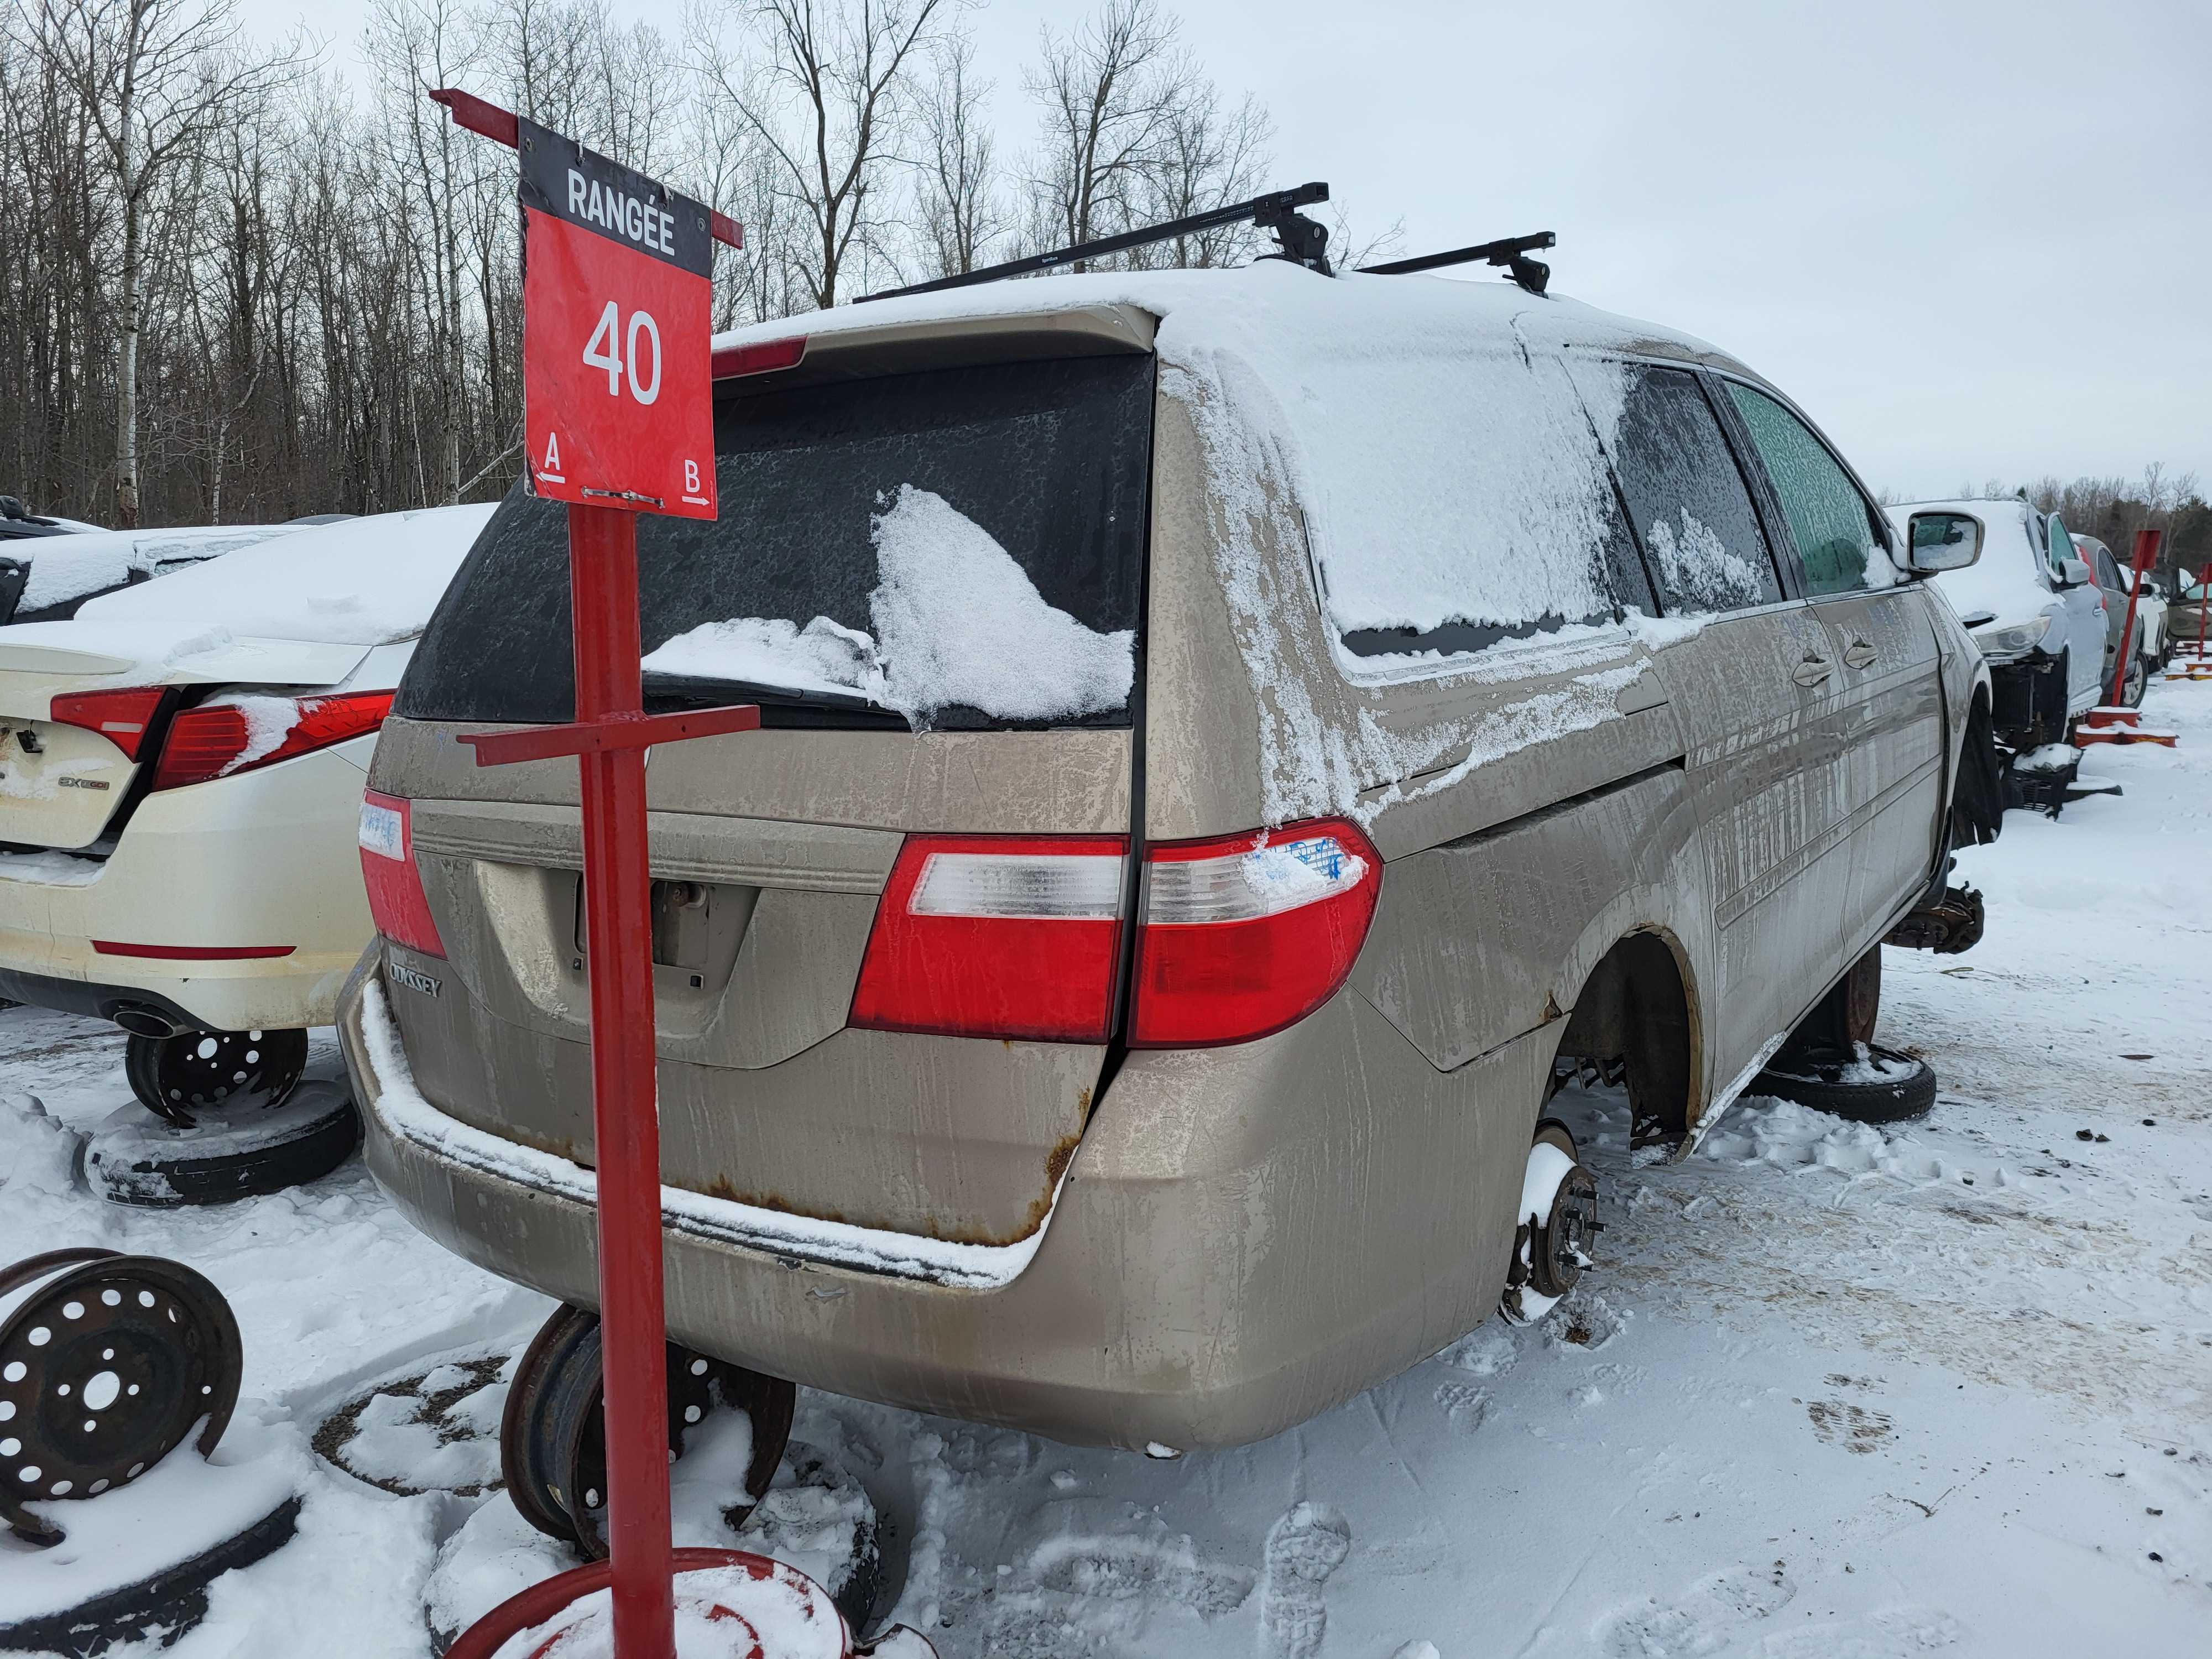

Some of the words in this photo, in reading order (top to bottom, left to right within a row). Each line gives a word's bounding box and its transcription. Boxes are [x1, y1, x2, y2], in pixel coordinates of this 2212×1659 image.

[567, 168, 675, 257] RANGÉE
[582, 300, 662, 406] 40
[545, 432, 561, 471] A
[684, 458, 701, 494] B
[389, 962, 442, 998] ODYSSEY
